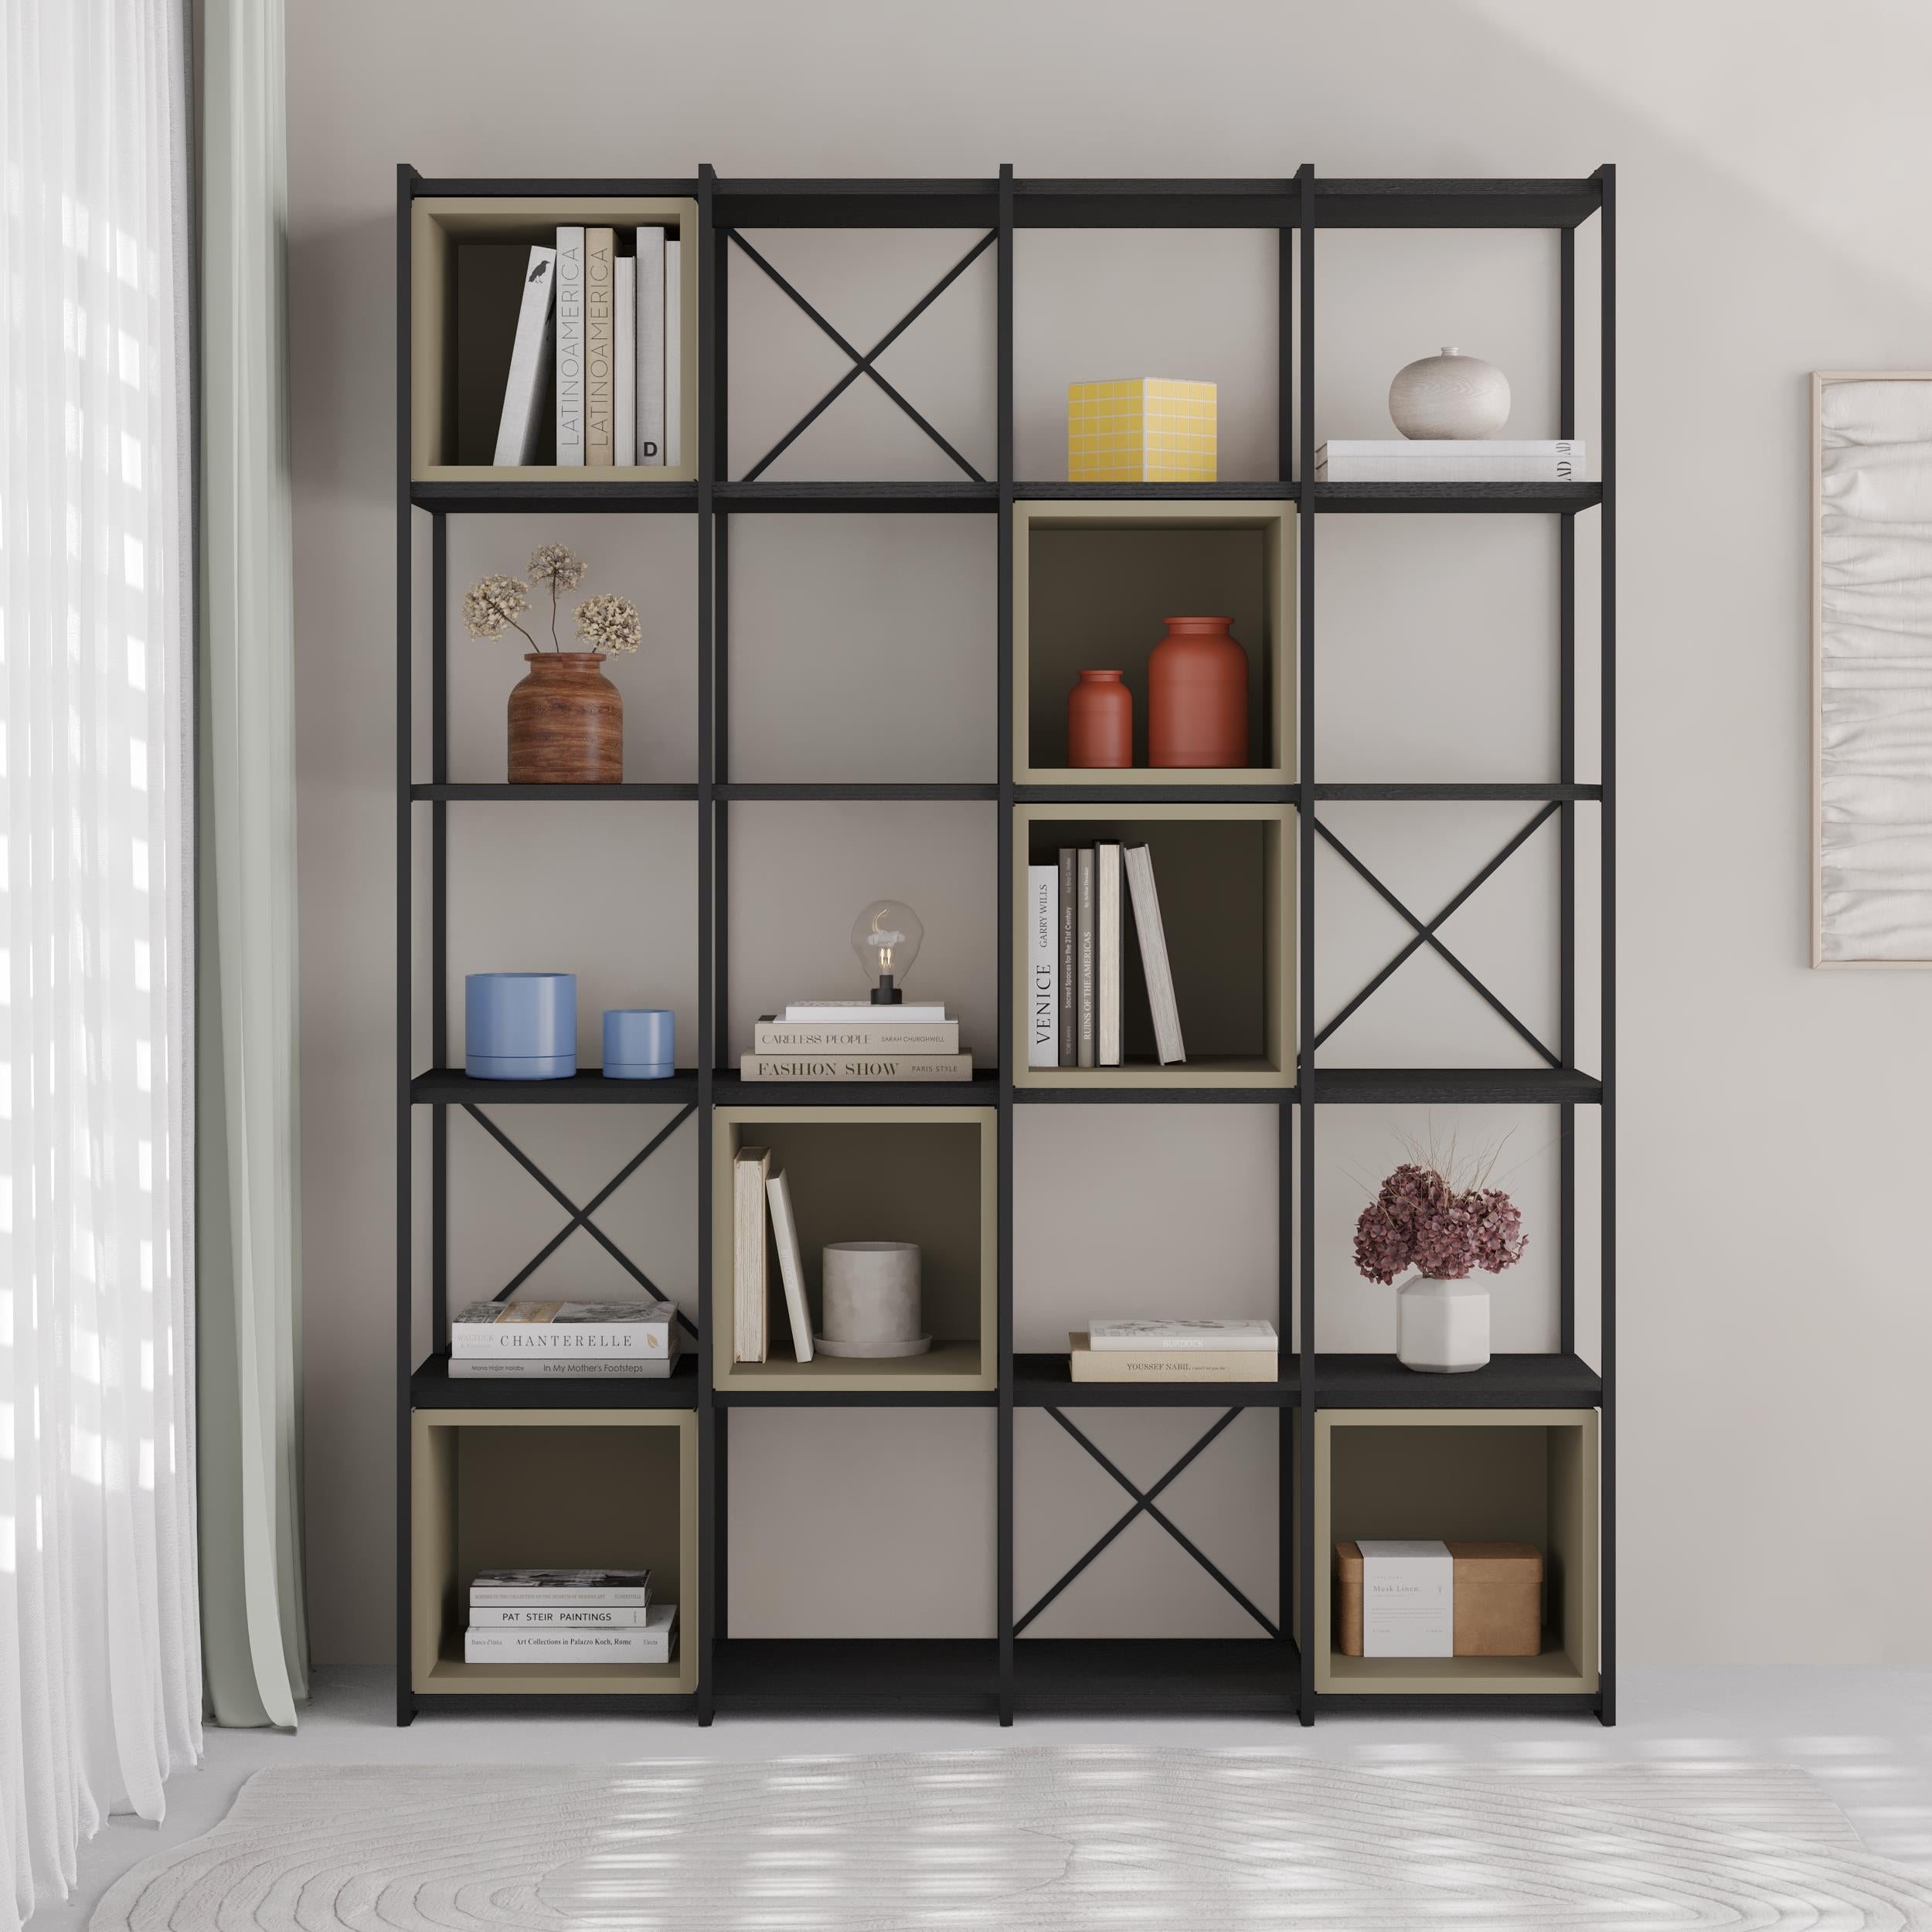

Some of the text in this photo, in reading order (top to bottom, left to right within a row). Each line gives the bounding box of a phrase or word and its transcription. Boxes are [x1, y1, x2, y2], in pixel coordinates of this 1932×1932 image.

[562, 247, 579, 445] LATINOAMERICA
[590, 247, 608, 446] LATINOAMERICA
[644, 442, 658, 457] D
[1065, 906, 1073, 930] Century
[1065, 964, 1073, 986] Spaces
[1036, 964, 1051, 1046] VENICE
[1083, 999, 1091, 1012] OF
[826, 1035, 872, 1045] PEOPLE
[758, 1063, 899, 1076] FASHION SHOW
[500, 1335, 633, 1347] CHANTERELLE
[543, 1364, 643, 1374] In My Mother's Footsteps
[594, 1638, 613, 1646] Koch,
